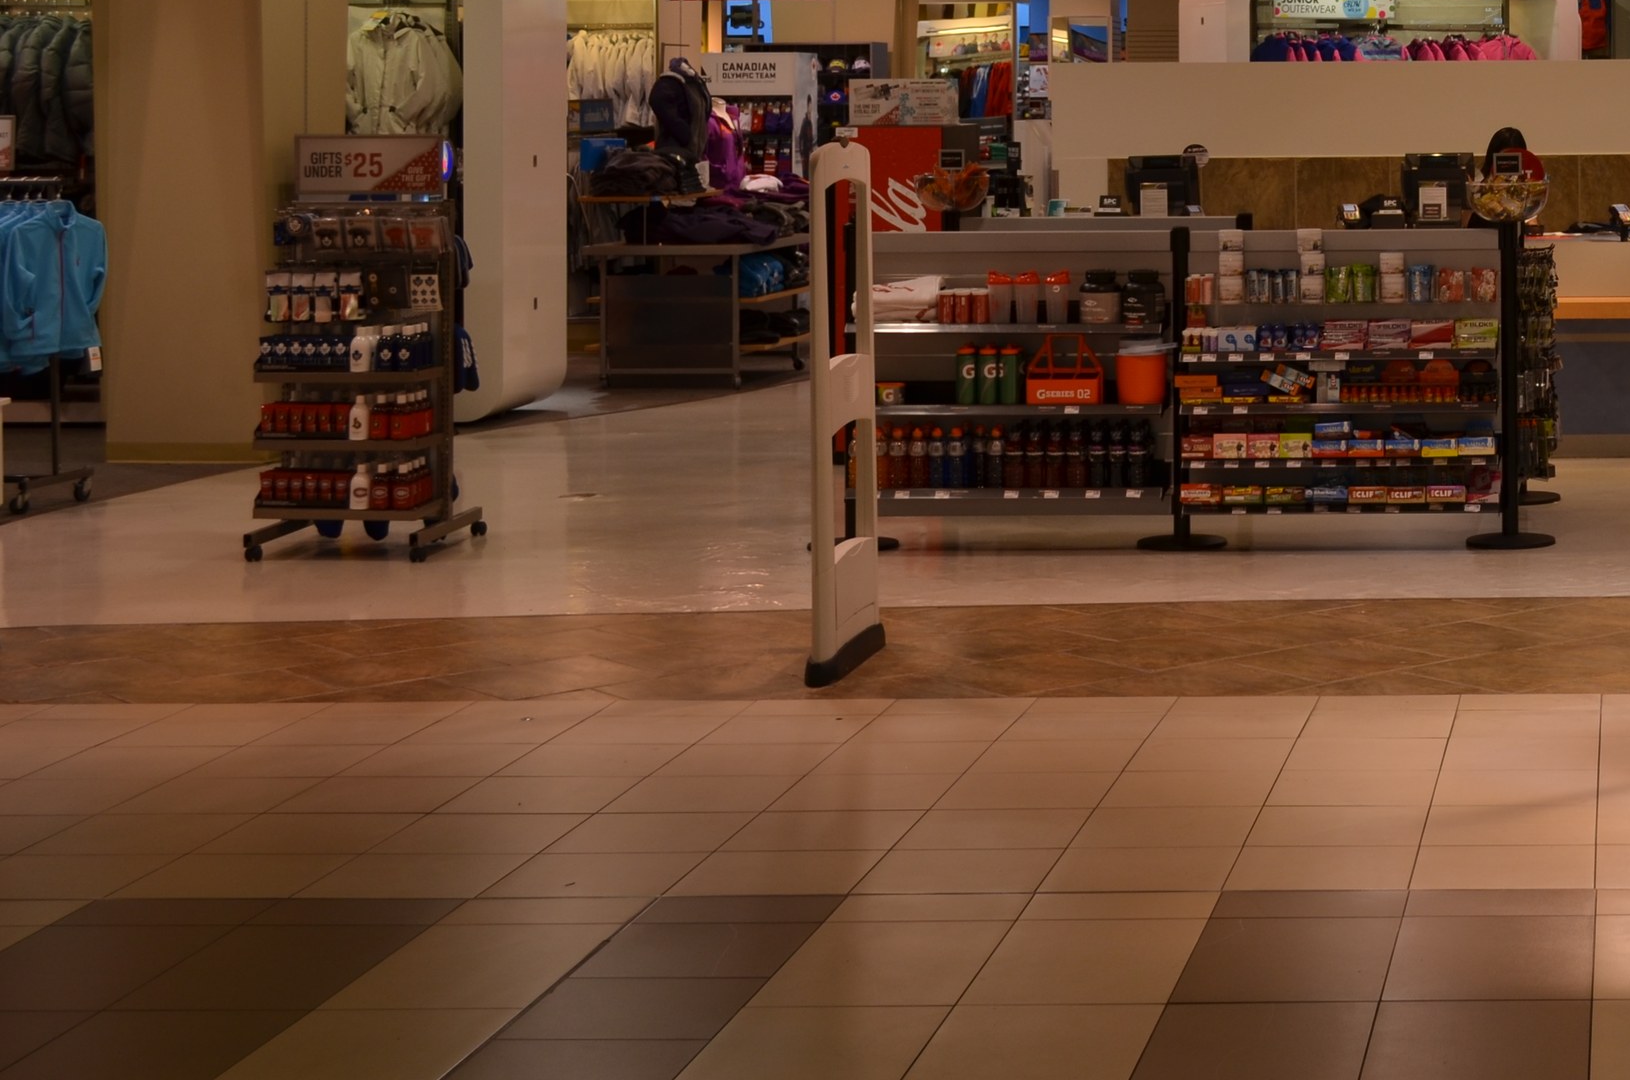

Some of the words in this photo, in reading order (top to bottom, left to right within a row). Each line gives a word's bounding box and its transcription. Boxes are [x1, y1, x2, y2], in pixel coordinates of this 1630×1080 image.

[1281, 4, 1336, 13] OUTERWEAR
[722, 62, 776, 71] CANADIAN
[310, 152, 342, 165] GIFTS
[344, 151, 383, 178] $25
[304, 165, 343, 178] UNDER
[962, 363, 976, 379] G
[984, 363, 997, 378] G
[882, 389, 894, 402] G
[1077, 389, 1091, 399] 02
[1356, 490, 1374, 499] CLIF
[1394, 491, 1413, 499] CLIF
[1434, 489, 1453, 498] CLIF
